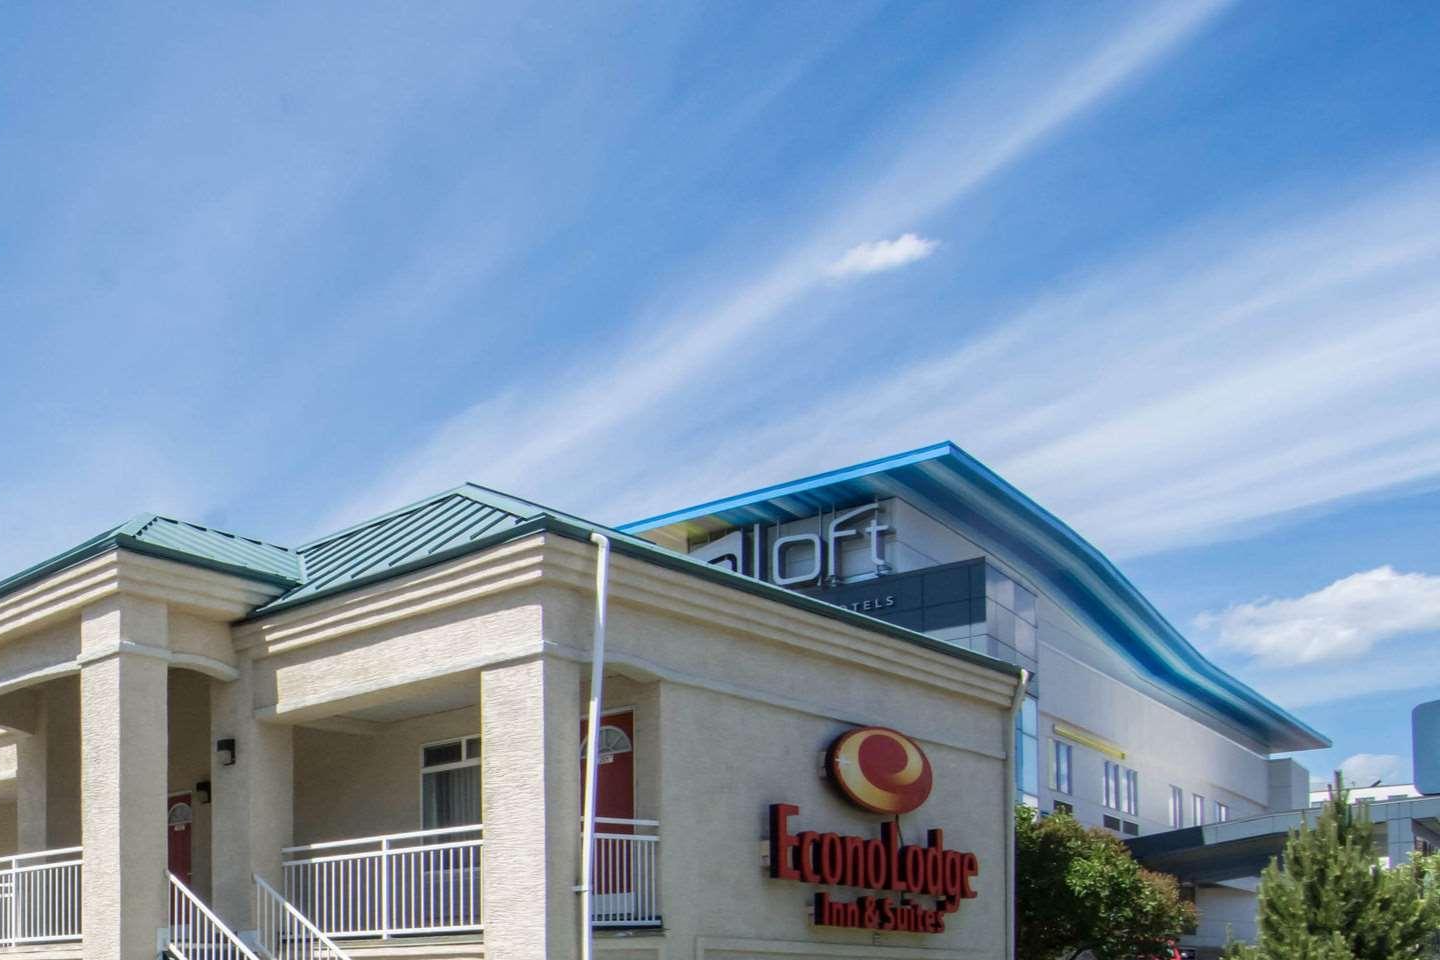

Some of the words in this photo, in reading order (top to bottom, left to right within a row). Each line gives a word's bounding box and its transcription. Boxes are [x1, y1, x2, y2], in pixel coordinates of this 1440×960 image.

[816, 892, 859, 927] Inn
[863, 895, 880, 930] &
[883, 896, 946, 933] Suites
